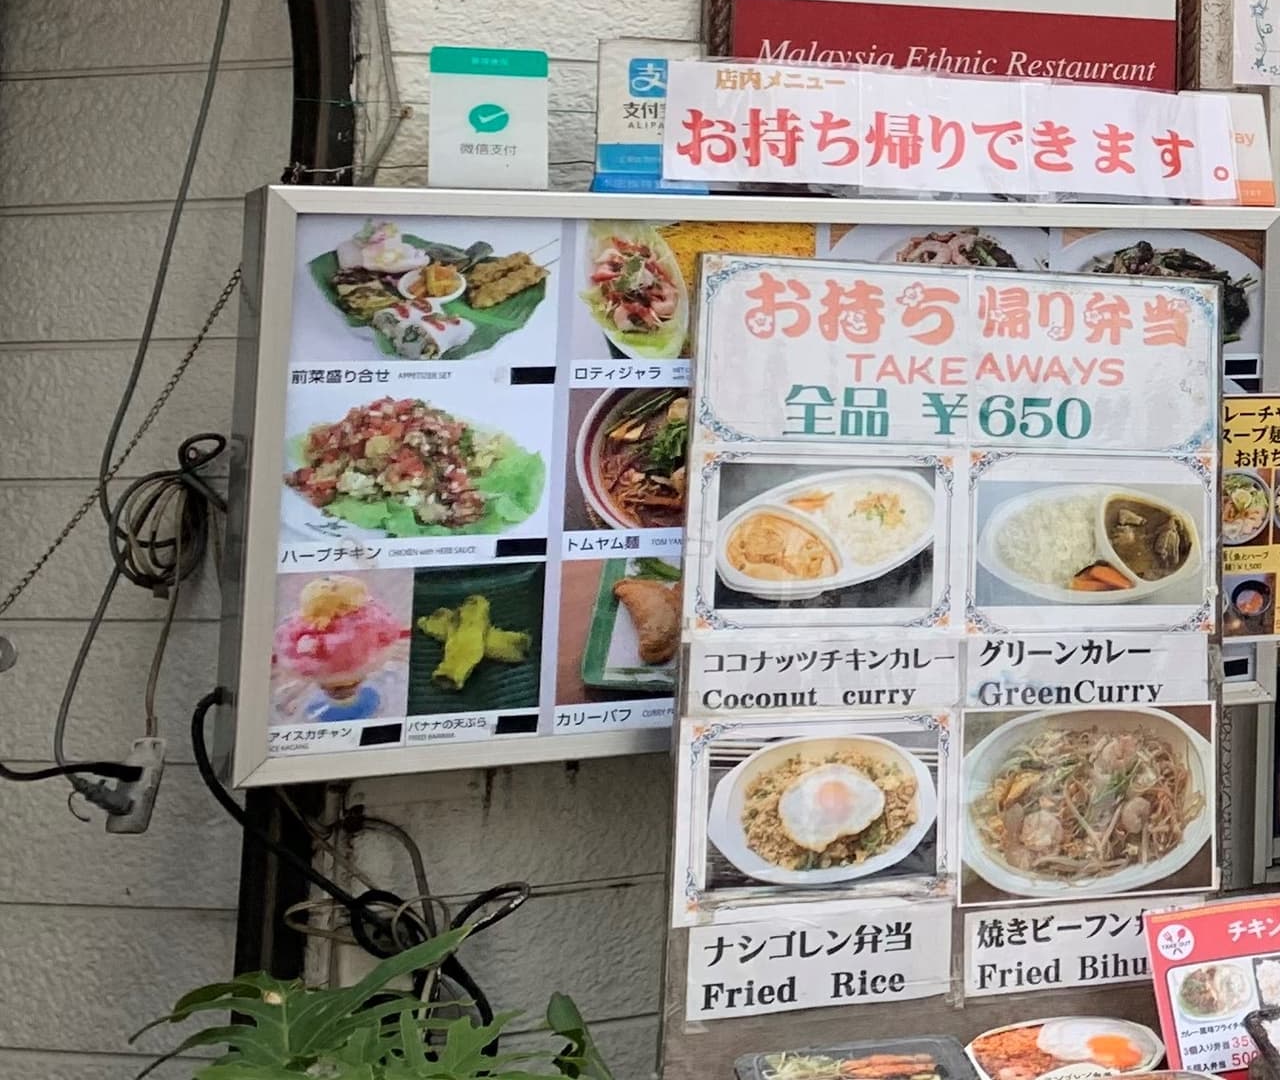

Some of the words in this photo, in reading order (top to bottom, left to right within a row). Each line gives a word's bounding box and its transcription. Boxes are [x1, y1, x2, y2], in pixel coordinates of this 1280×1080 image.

[756, 37, 897, 71] Malaysia
[904, 45, 999, 77] Ethnic
[1004, 50, 1158, 83] Restaurant
[714, 68, 847, 92] 店内メニュー
[675, 103, 1231, 183] お持ち帰りできます。
[291, 368, 390, 385] 前菜盛り合せ
[575, 366, 662, 381] ロティジャラ
[846, 351, 968, 387] TAKE
[974, 351, 1126, 387] AWAYS
[782, 384, 890, 438] 全品
[922, 390, 1093, 441] ¥650
[281, 546, 382, 564] ハーブチキン
[568, 535, 640, 552] トムヤム麺
[703, 647, 956, 675] ココナッツチキンカレー
[979, 638, 1152, 669] グリーンカレー
[702, 687, 818, 710] Coconut
[842, 684, 917, 708] curry
[408, 716, 488, 732] バナナの天ぷら
[556, 708, 632, 727] カリーパフ
[269, 727, 352, 742] アイスカチャン
[703, 922, 913, 969] ナシゴレン弁当
[977, 953, 1063, 990] Fried
[700, 978, 798, 1011] Fried
[830, 969, 906, 999] Rice
